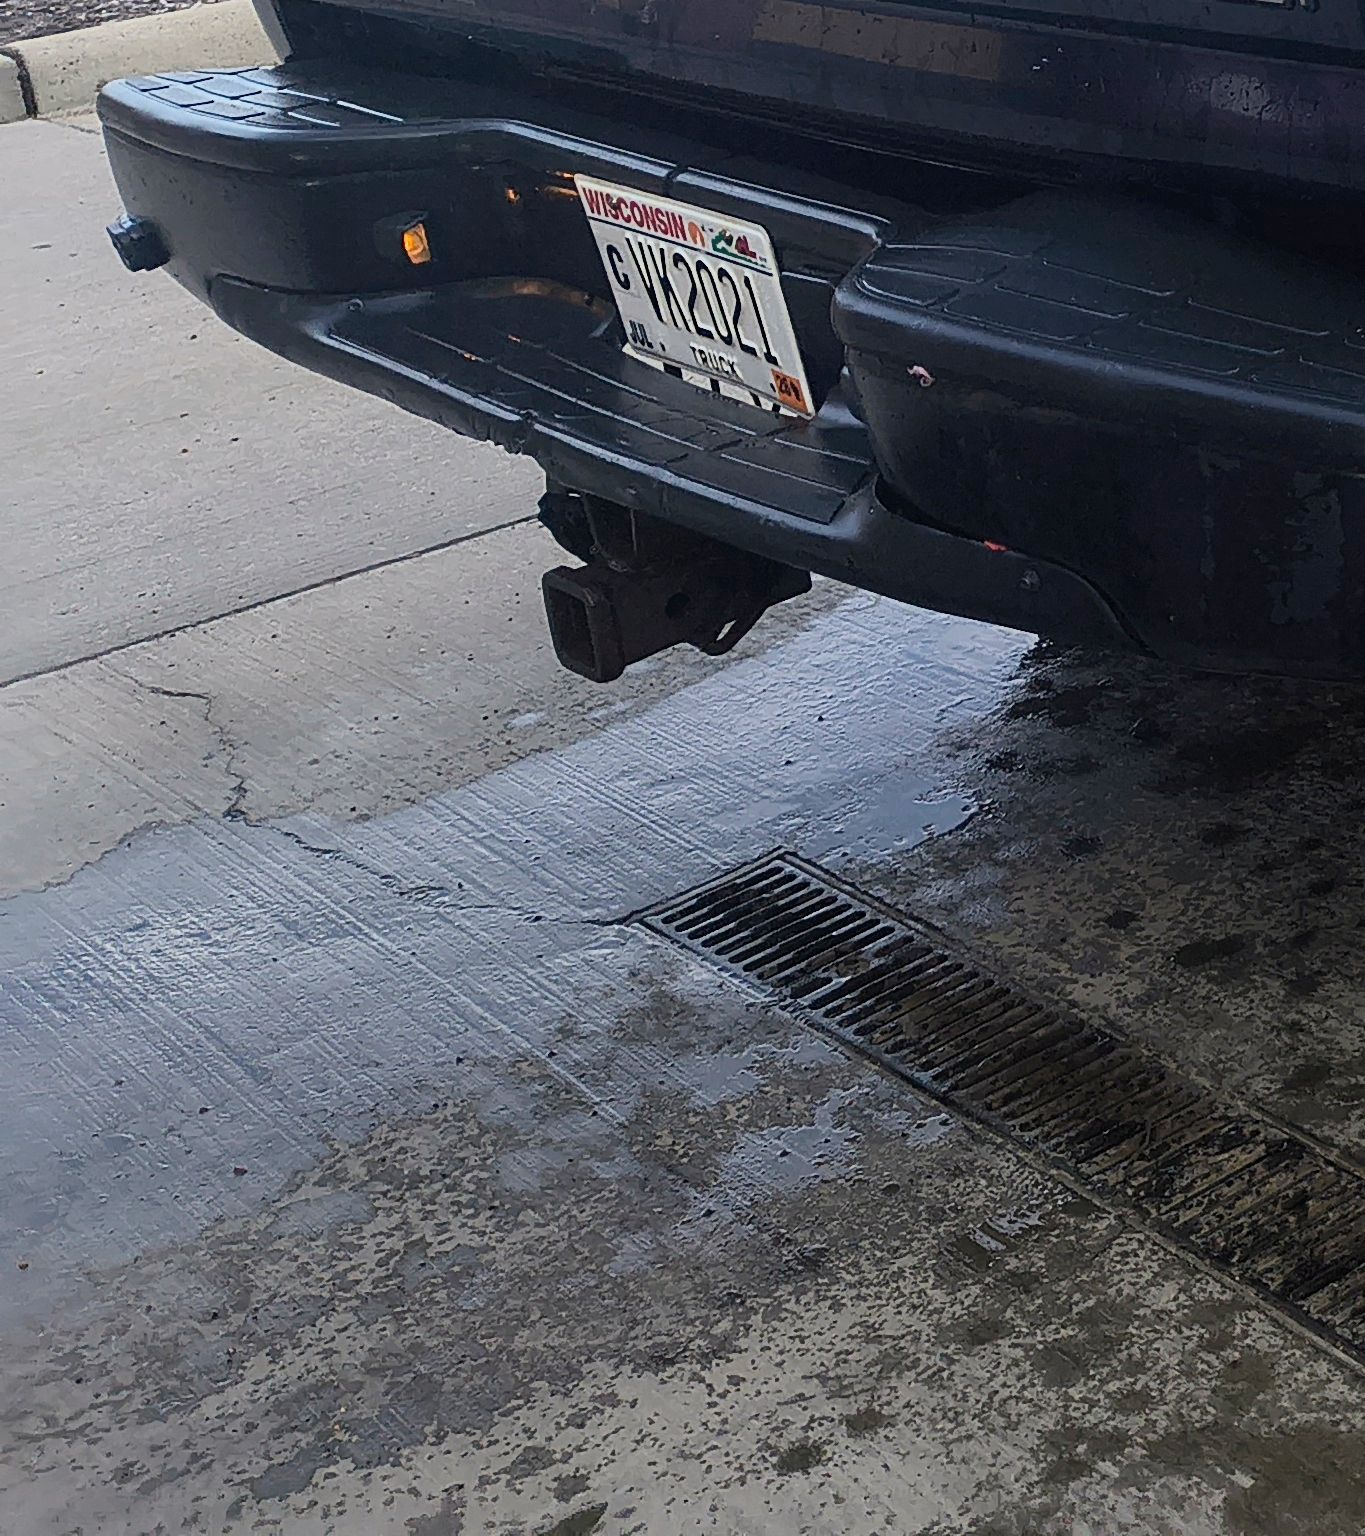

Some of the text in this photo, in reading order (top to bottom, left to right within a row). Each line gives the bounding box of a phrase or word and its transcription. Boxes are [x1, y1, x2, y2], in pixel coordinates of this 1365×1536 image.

[582, 187, 688, 242] WISCONSIN
[629, 319, 654, 349] JUL
[690, 345, 742, 381] TRUCK
